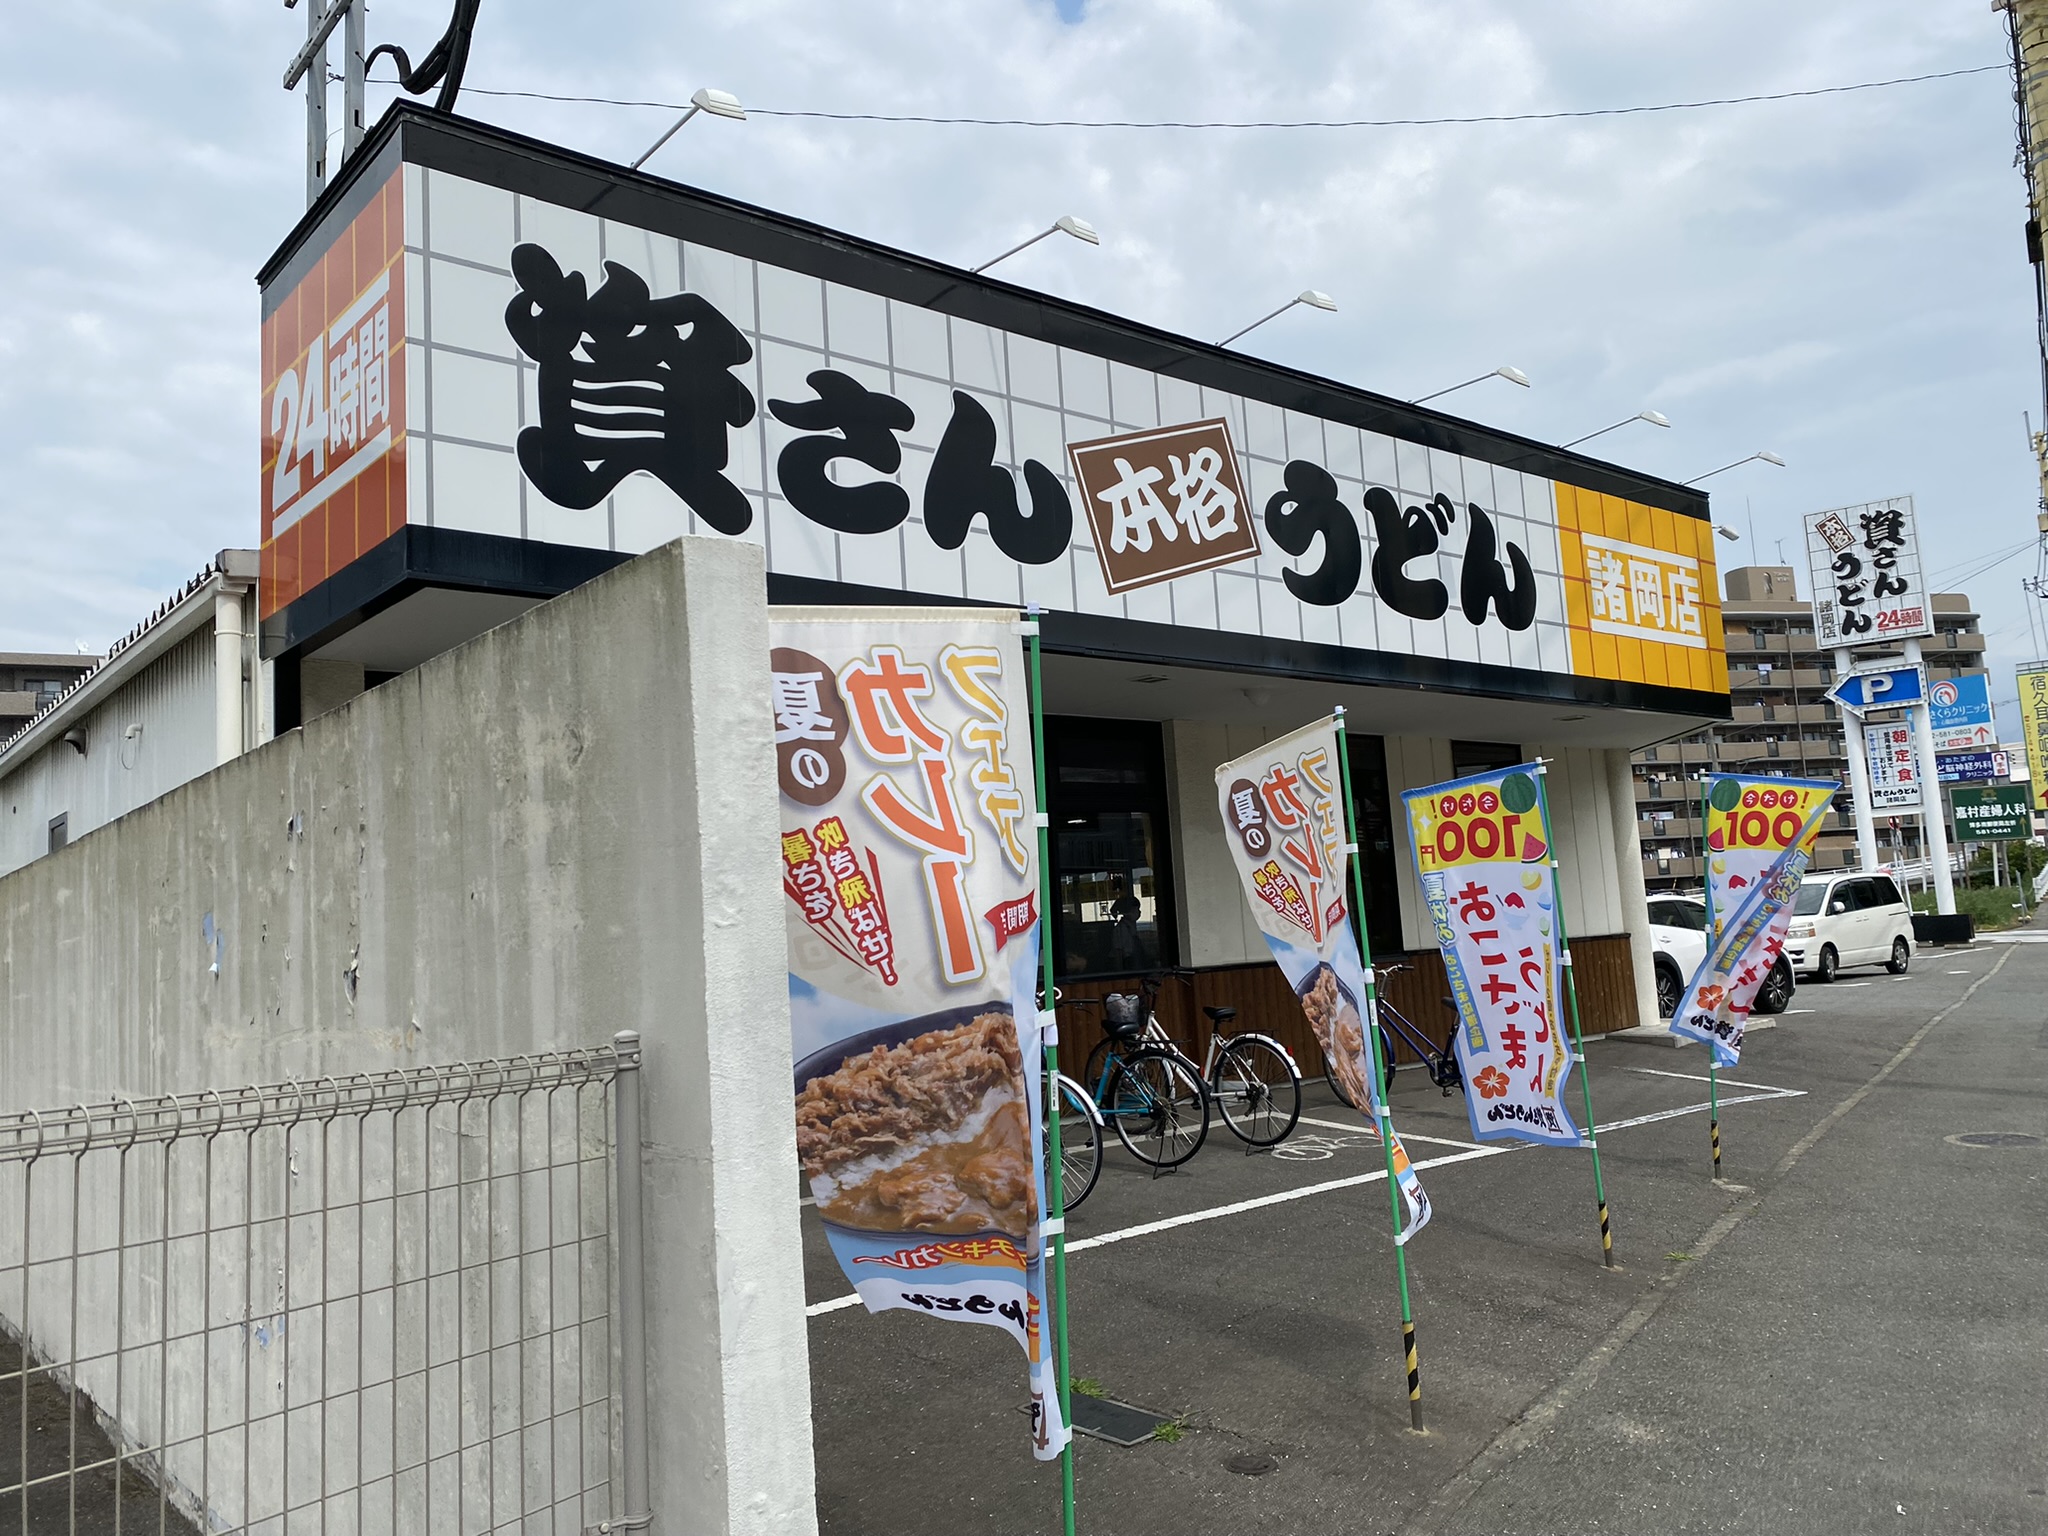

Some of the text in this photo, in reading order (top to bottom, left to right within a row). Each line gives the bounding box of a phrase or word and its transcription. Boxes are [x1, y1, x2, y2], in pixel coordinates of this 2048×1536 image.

[271, 301, 390, 512] 24時間
[1097, 446, 1240, 555] 本格
[1264, 460, 1537, 631] うどん
[1860, 510, 1908, 599] 資さん
[1587, 549, 1702, 635] 諸岡店
[1831, 553, 1872, 636] うどん
[1876, 609, 1923, 628] 24時間
[1860, 674, 1893, 703] P
[1892, 730, 1914, 782] 朝定食
[1745, 791, 1810, 810] 今だけ!
[1955, 803, 2027, 820] 嘉村産婦人科
